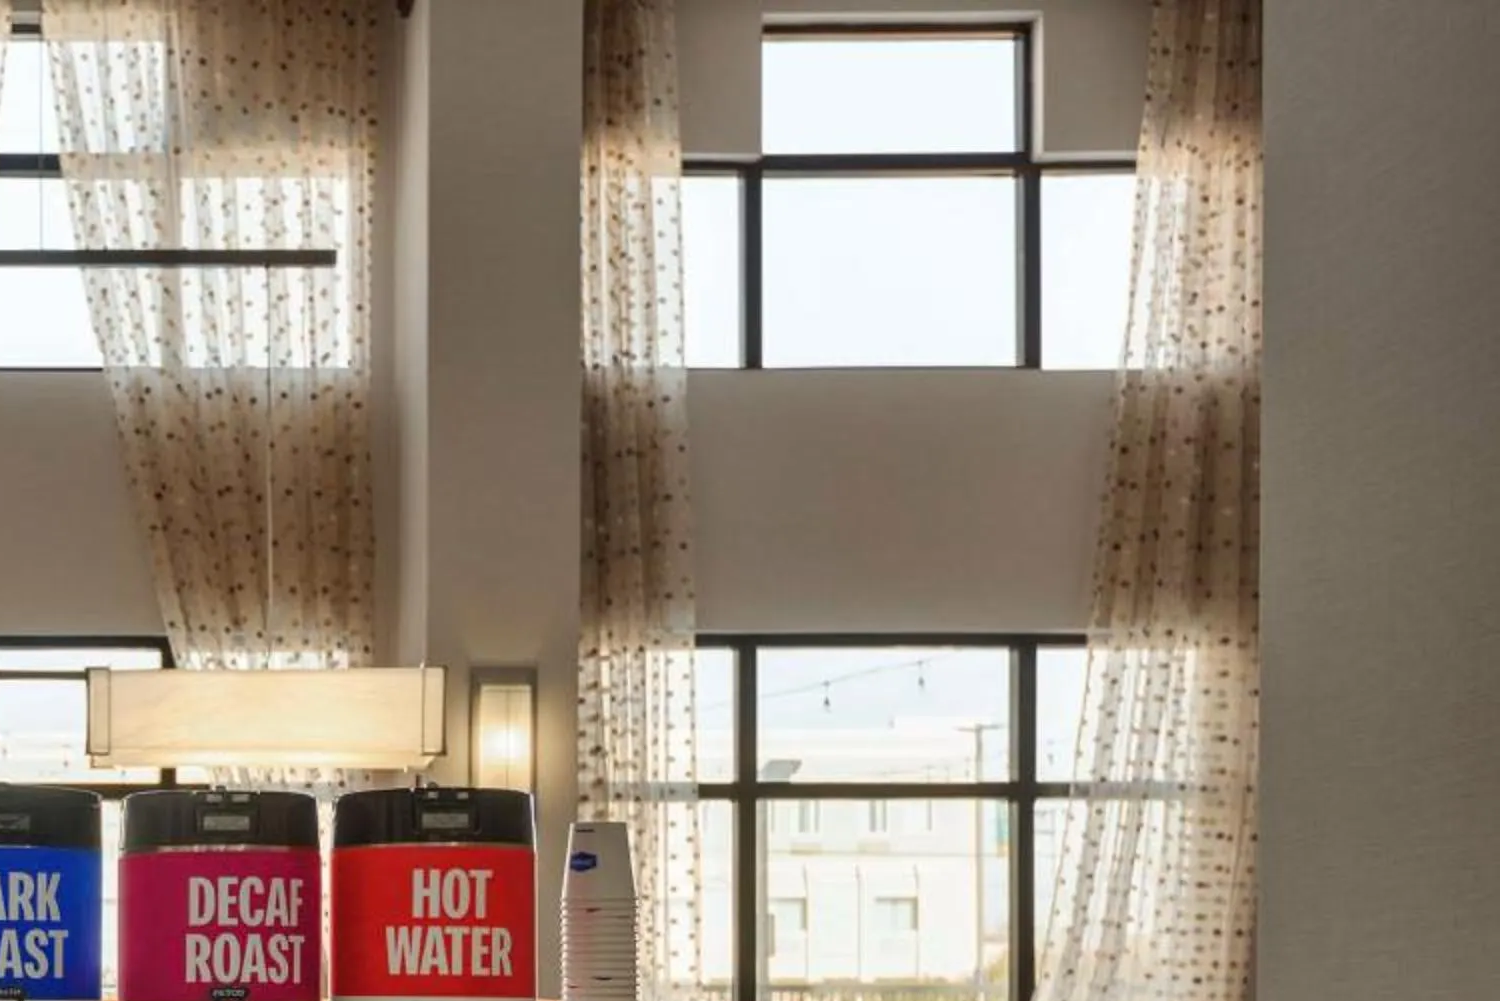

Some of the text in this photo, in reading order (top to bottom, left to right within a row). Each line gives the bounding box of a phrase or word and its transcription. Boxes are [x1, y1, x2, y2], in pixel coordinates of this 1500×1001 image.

[188, 876, 304, 928] DECAF
[411, 868, 492, 919] HOT
[185, 932, 305, 985] ROAST
[385, 925, 512, 977] WATER
